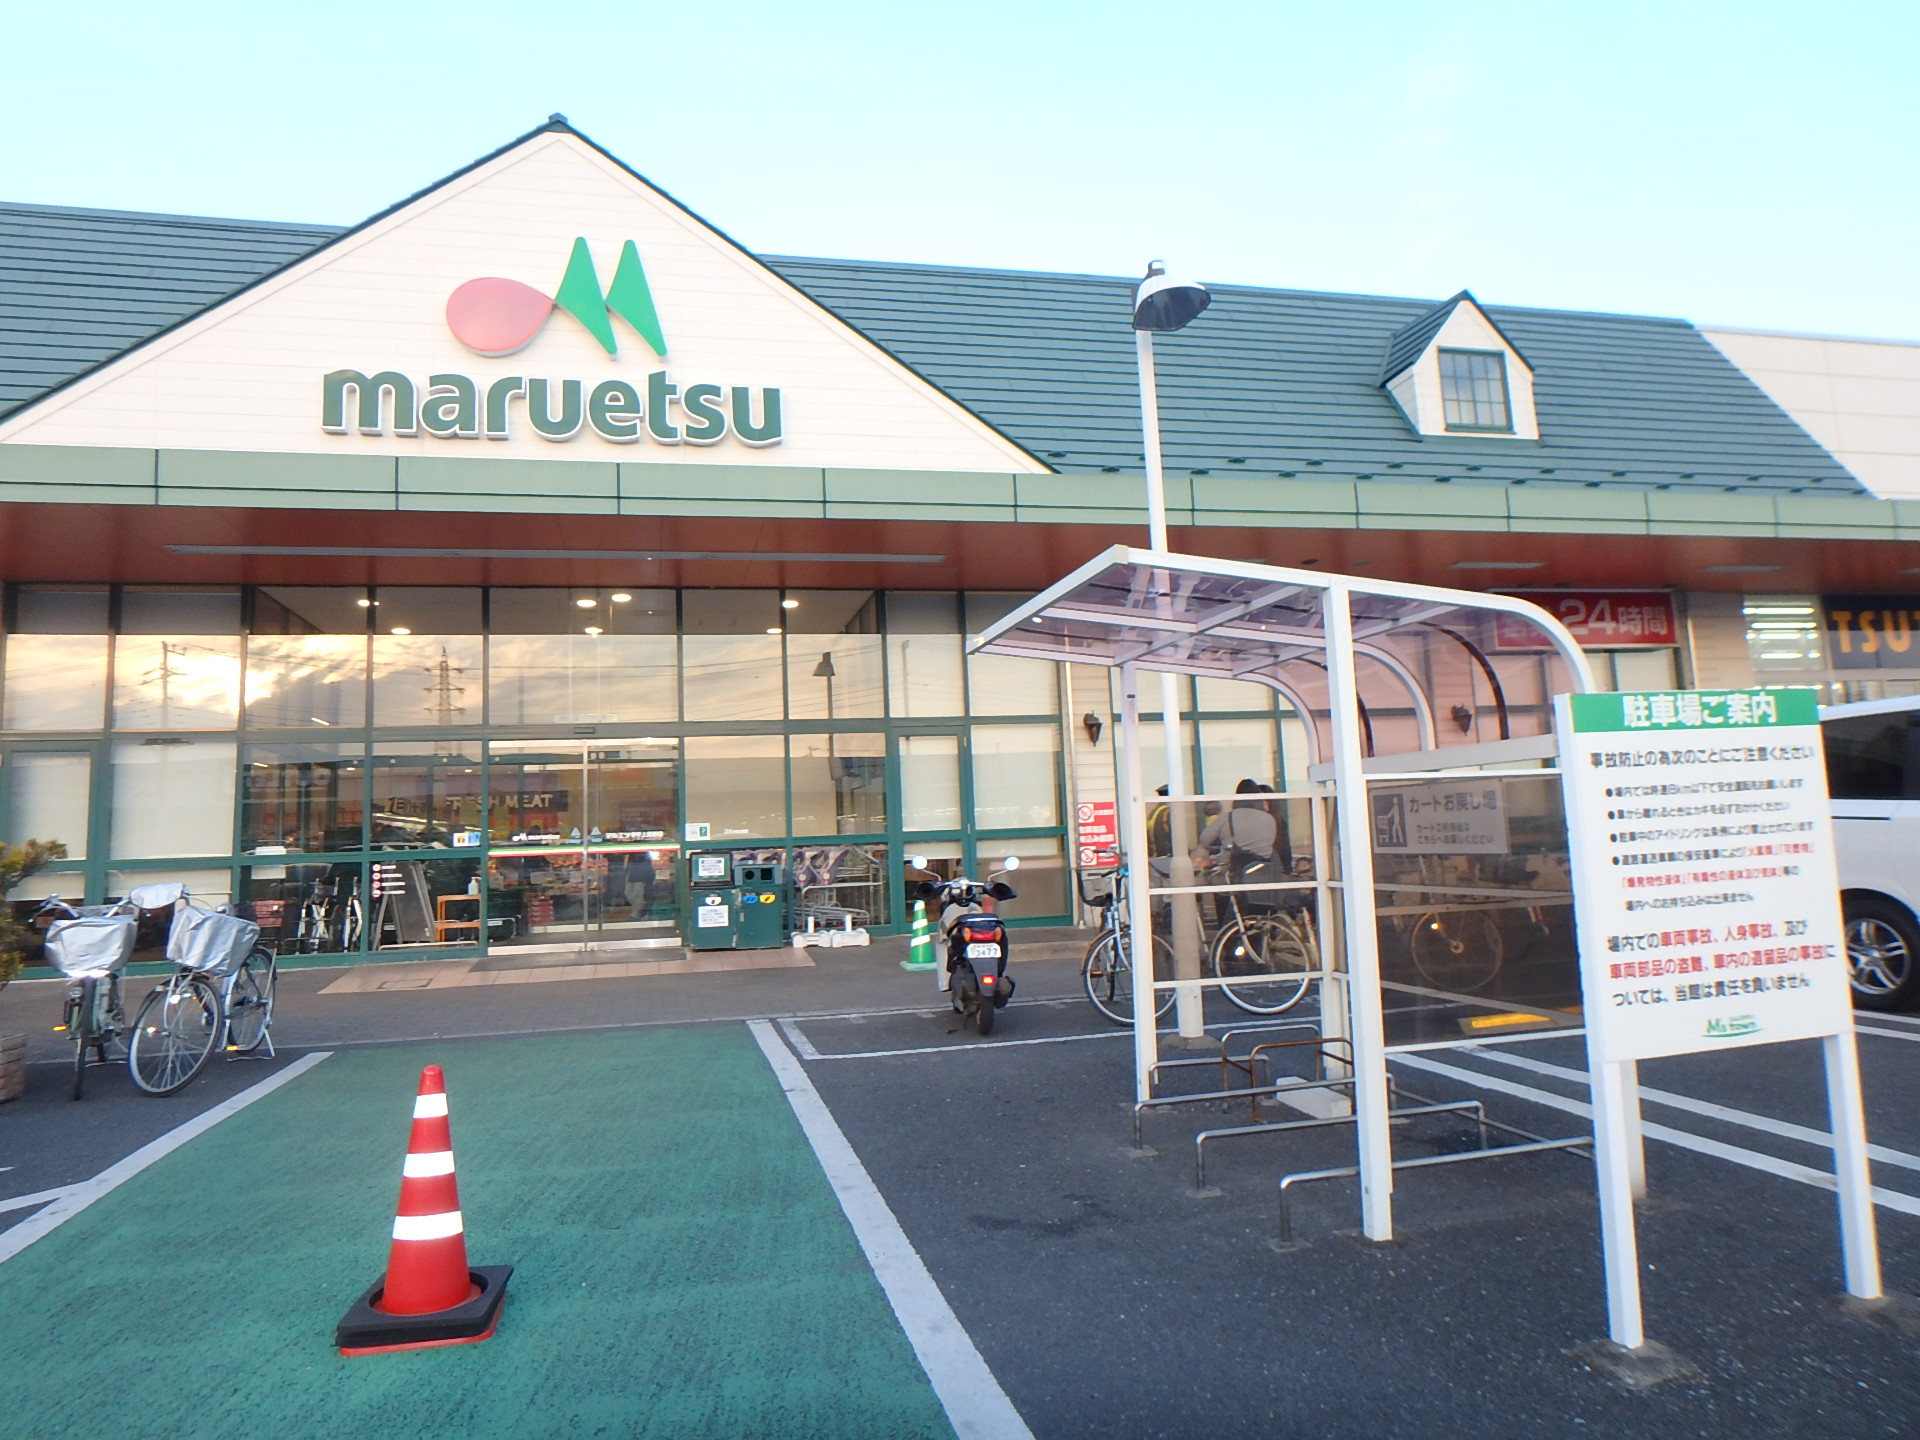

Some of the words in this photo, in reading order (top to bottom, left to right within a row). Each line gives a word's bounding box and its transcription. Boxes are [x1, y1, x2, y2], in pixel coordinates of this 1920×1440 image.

[321, 368, 784, 449] maruetsu
[1623, 692, 1777, 728] 駐車場ご案内
[1590, 746, 1814, 768] 事故防止の為次のことにご注意ください
[505, 794, 553, 809] MEAT
[1409, 790, 1497, 814] カートお戻し場
